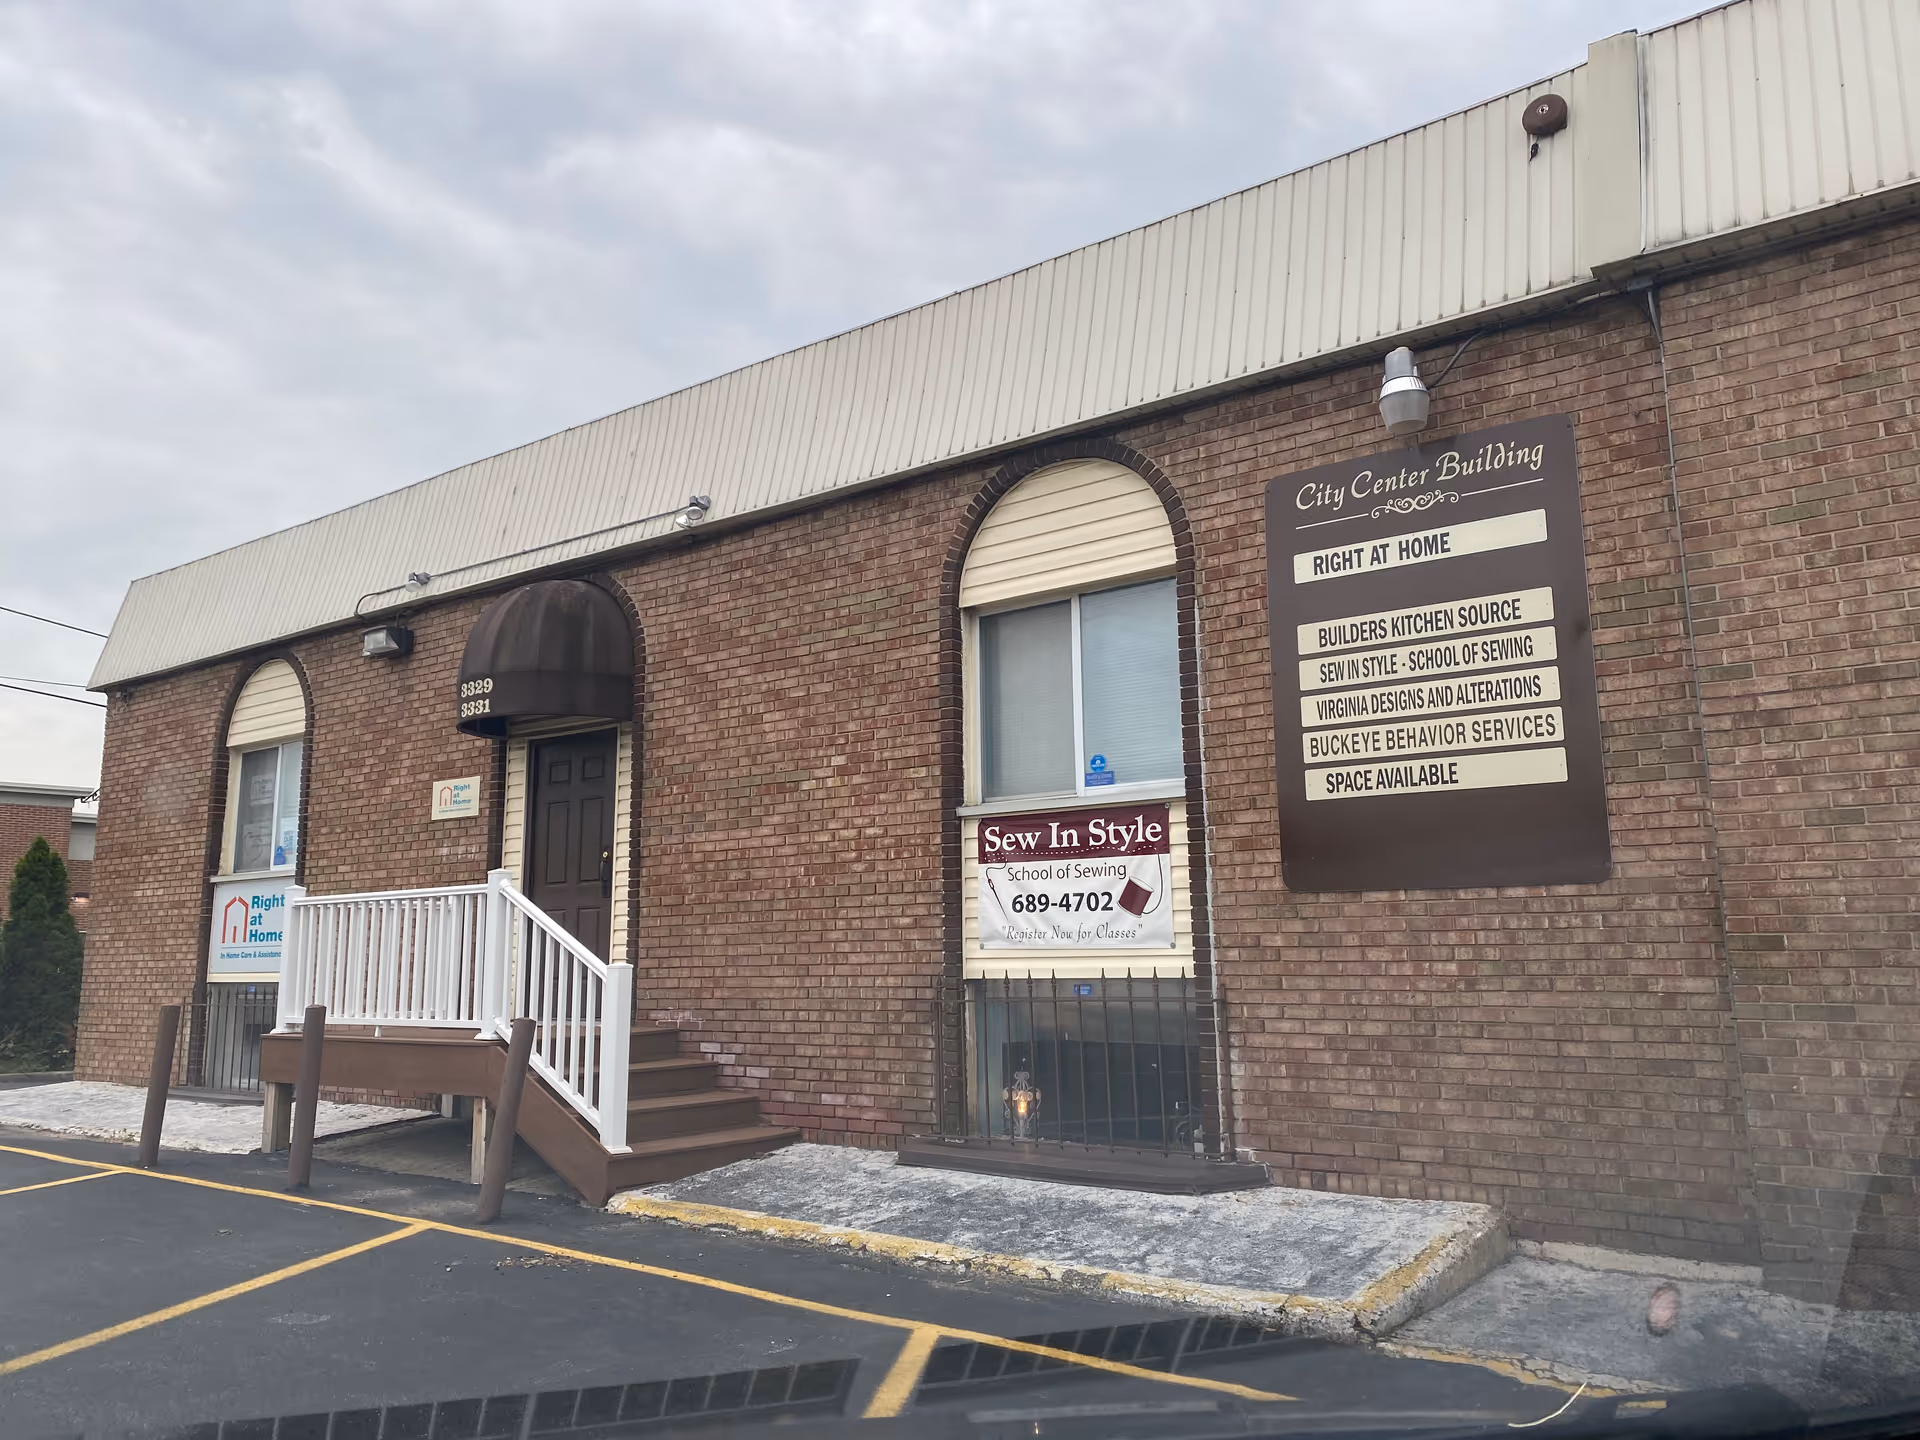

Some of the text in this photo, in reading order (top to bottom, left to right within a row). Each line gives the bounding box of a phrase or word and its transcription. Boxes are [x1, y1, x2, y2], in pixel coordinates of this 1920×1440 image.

[1295, 442, 1544, 510] City Center Building
[1313, 532, 1451, 576] RIGHT AT HOME
[1318, 598, 1522, 648] BUILDERS KITCHEN SOURCE
[1319, 662, 1345, 683] SEW
[1347, 659, 1360, 679] IN
[1362, 654, 1398, 677] STYLE
[1409, 646, 1460, 671] SCHOOL
[1462, 643, 1479, 664] OF
[1482, 635, 1534, 662] SEWING
[461, 678, 493, 698] 3329
[1317, 674, 1542, 721] VIRGINIA DESIGNS AND ALTERATIONS
[461, 699, 490, 717] 3331
[1310, 714, 1556, 757] BUCKEYE BEHAVIOR SERVICES
[453, 784, 470, 792] Right
[1326, 762, 1459, 793] SPACE AVAILABLE
[984, 815, 1162, 852] Sew In Style
[1007, 862, 1127, 882] School of Sewing
[251, 894, 285, 911] Right
[1012, 891, 1114, 913] 689-4702
[250, 913, 262, 926] at
[249, 930, 283, 942] Home
[1051, 925, 1073, 939] Now
[1077, 923, 1092, 943] for
